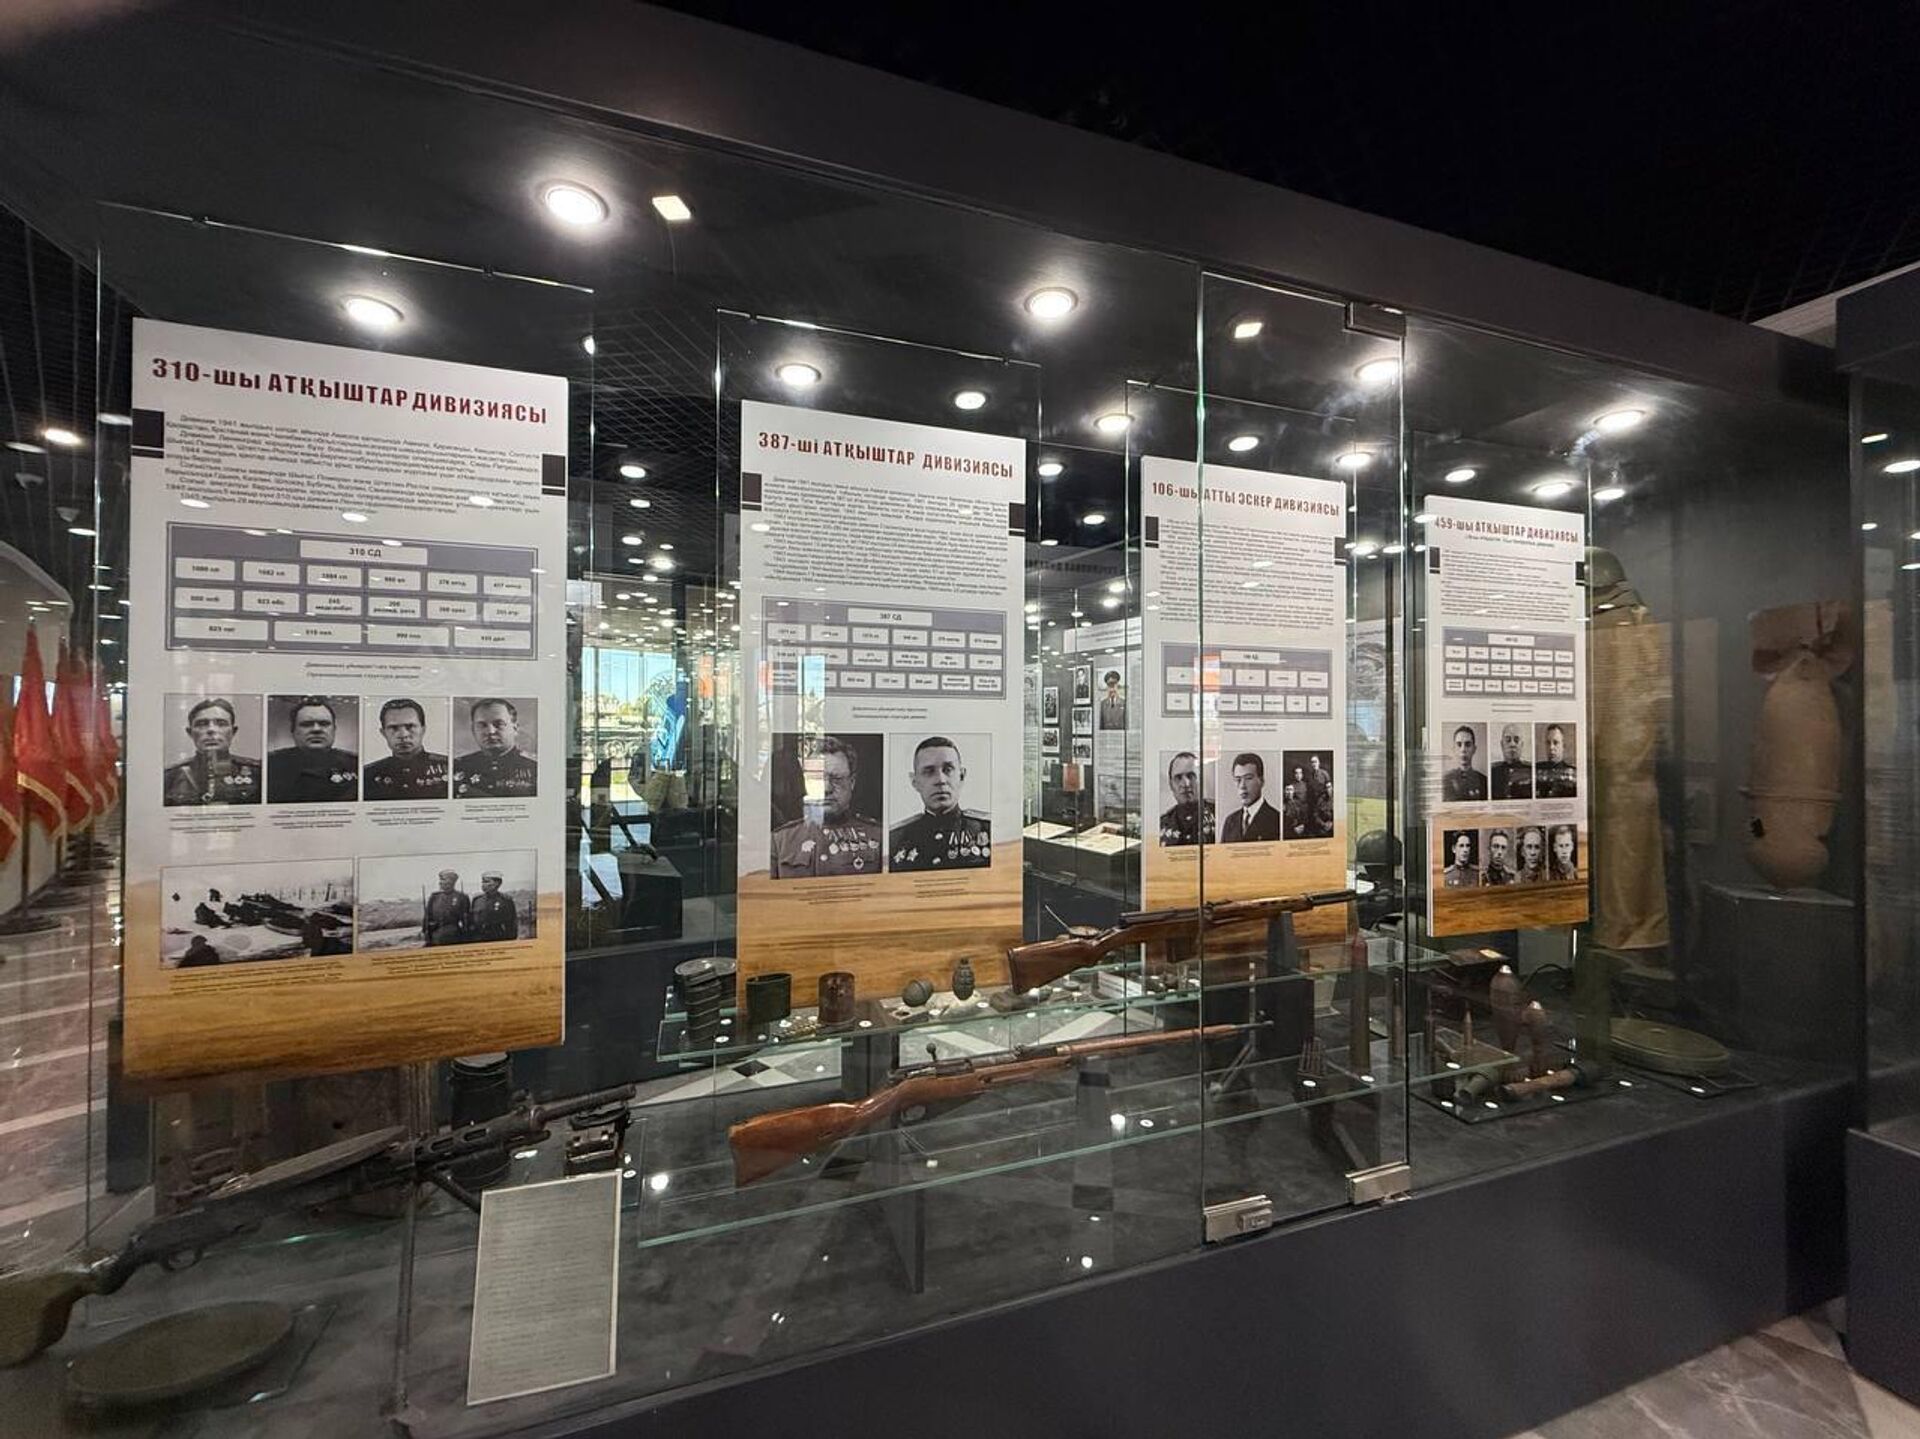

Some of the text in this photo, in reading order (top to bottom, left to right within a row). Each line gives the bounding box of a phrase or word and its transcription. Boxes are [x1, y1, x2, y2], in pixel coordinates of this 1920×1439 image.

[268, 373, 408, 407] АТҚЫШТАР
[412, 392, 547, 424] ДИВИЗИЯСЫ
[823, 441, 915, 466] АТҚЫШТАР
[922, 454, 1013, 478] ДИВИЗИЯСЫ
[1204, 488, 1235, 504] АТТЫ
[1275, 497, 1339, 516] ДИВИЗИЯСЫ
[1527, 526, 1578, 543] ДИВИЗИЯСЫ
[349, 547, 381, 558] 310 СД
